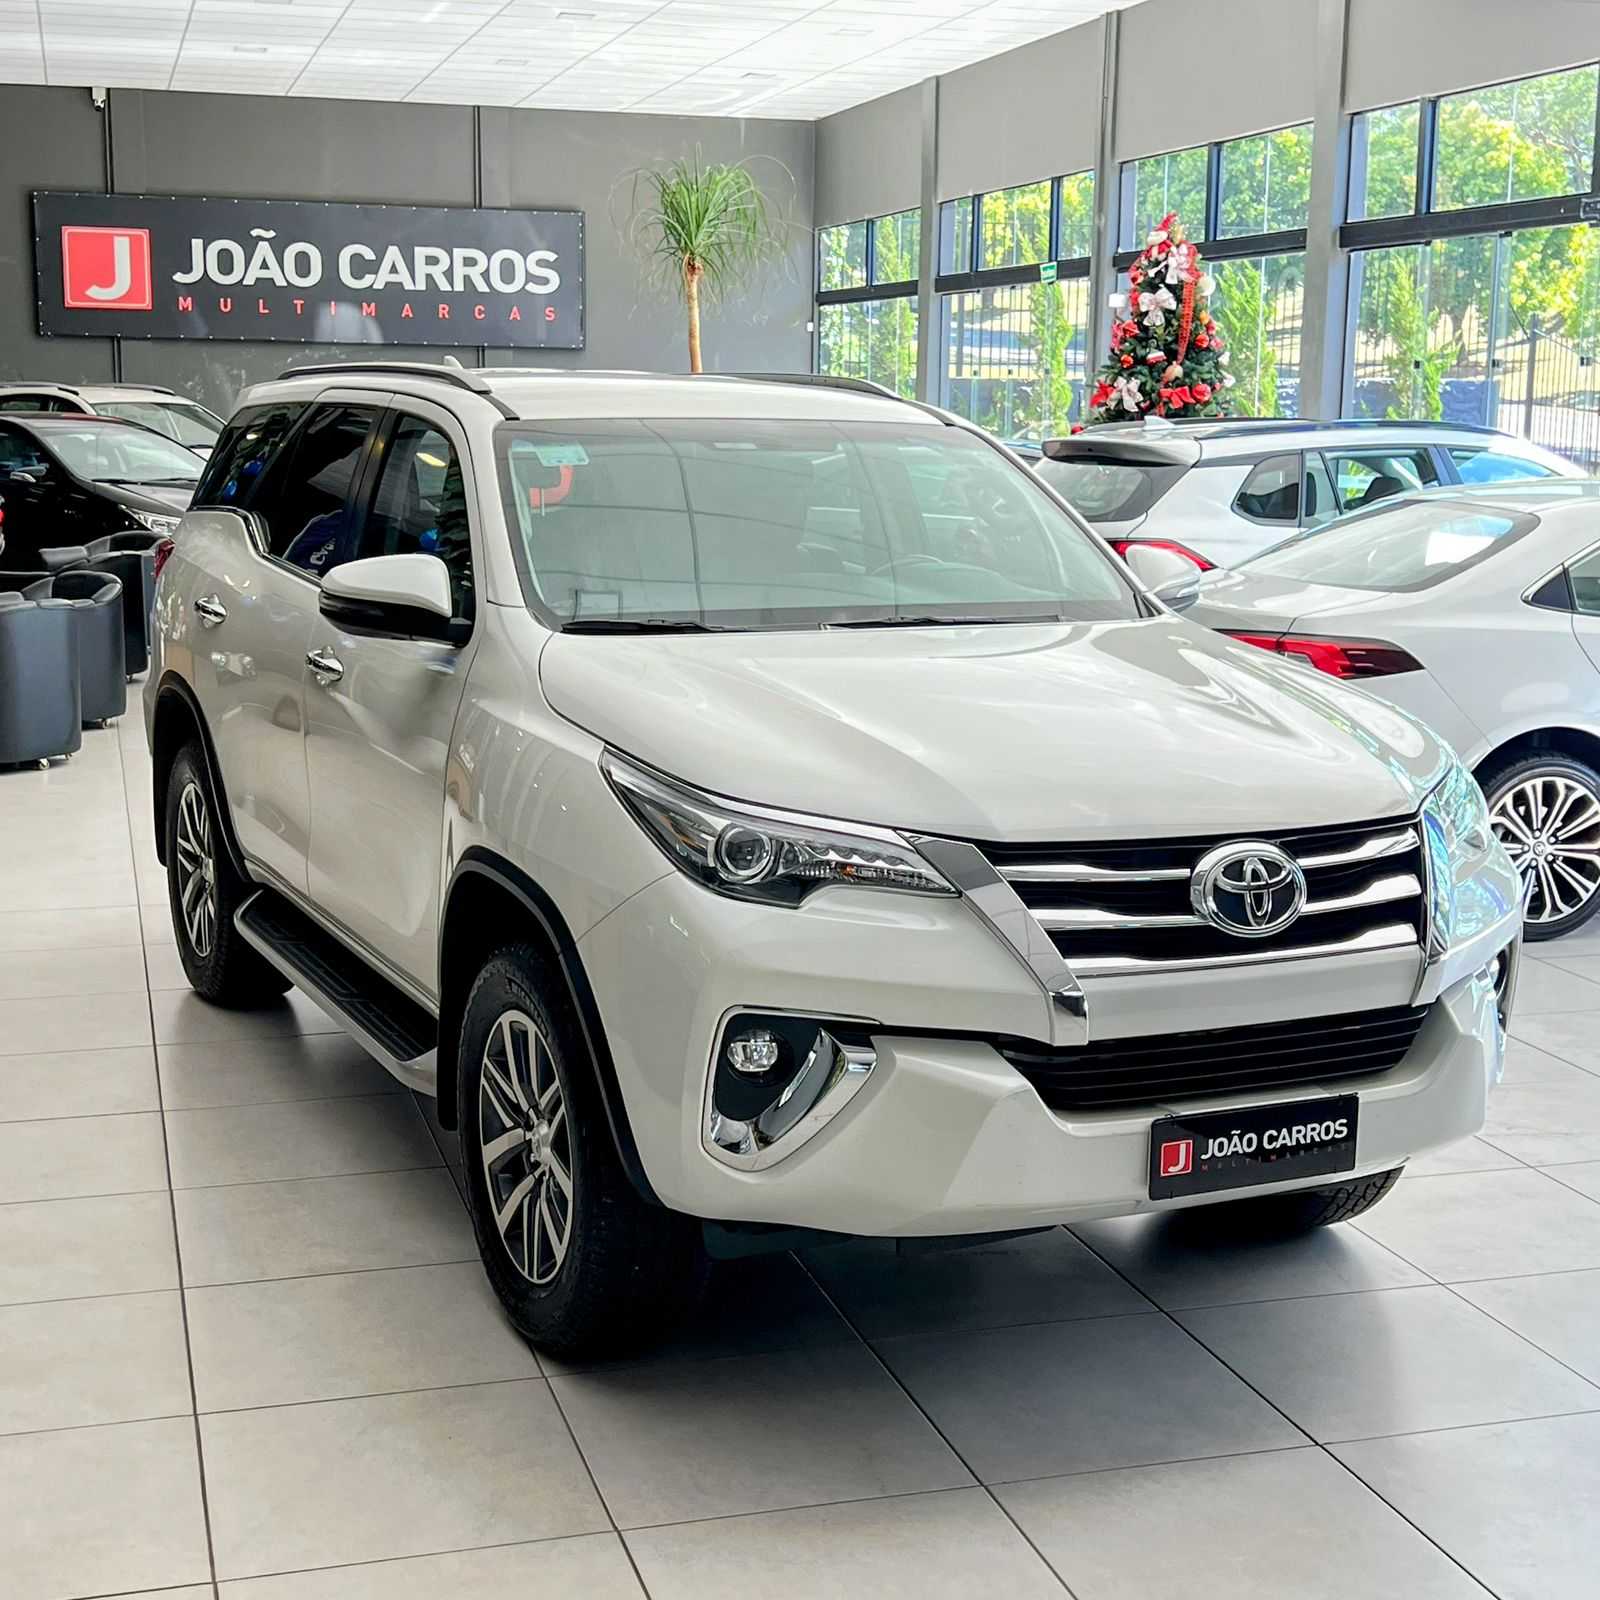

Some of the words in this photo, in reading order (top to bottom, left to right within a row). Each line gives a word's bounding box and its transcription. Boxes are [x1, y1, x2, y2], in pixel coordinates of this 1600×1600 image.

[84, 236, 132, 302] J
[172, 227, 323, 288] JOÃO
[338, 243, 562, 295] CARROS
[178, 297, 557, 323] MULTIMARCAS
[1167, 1143, 1187, 1173] J
[1200, 1130, 1258, 1160] JOÃO
[1263, 1118, 1348, 1150] CARROS
